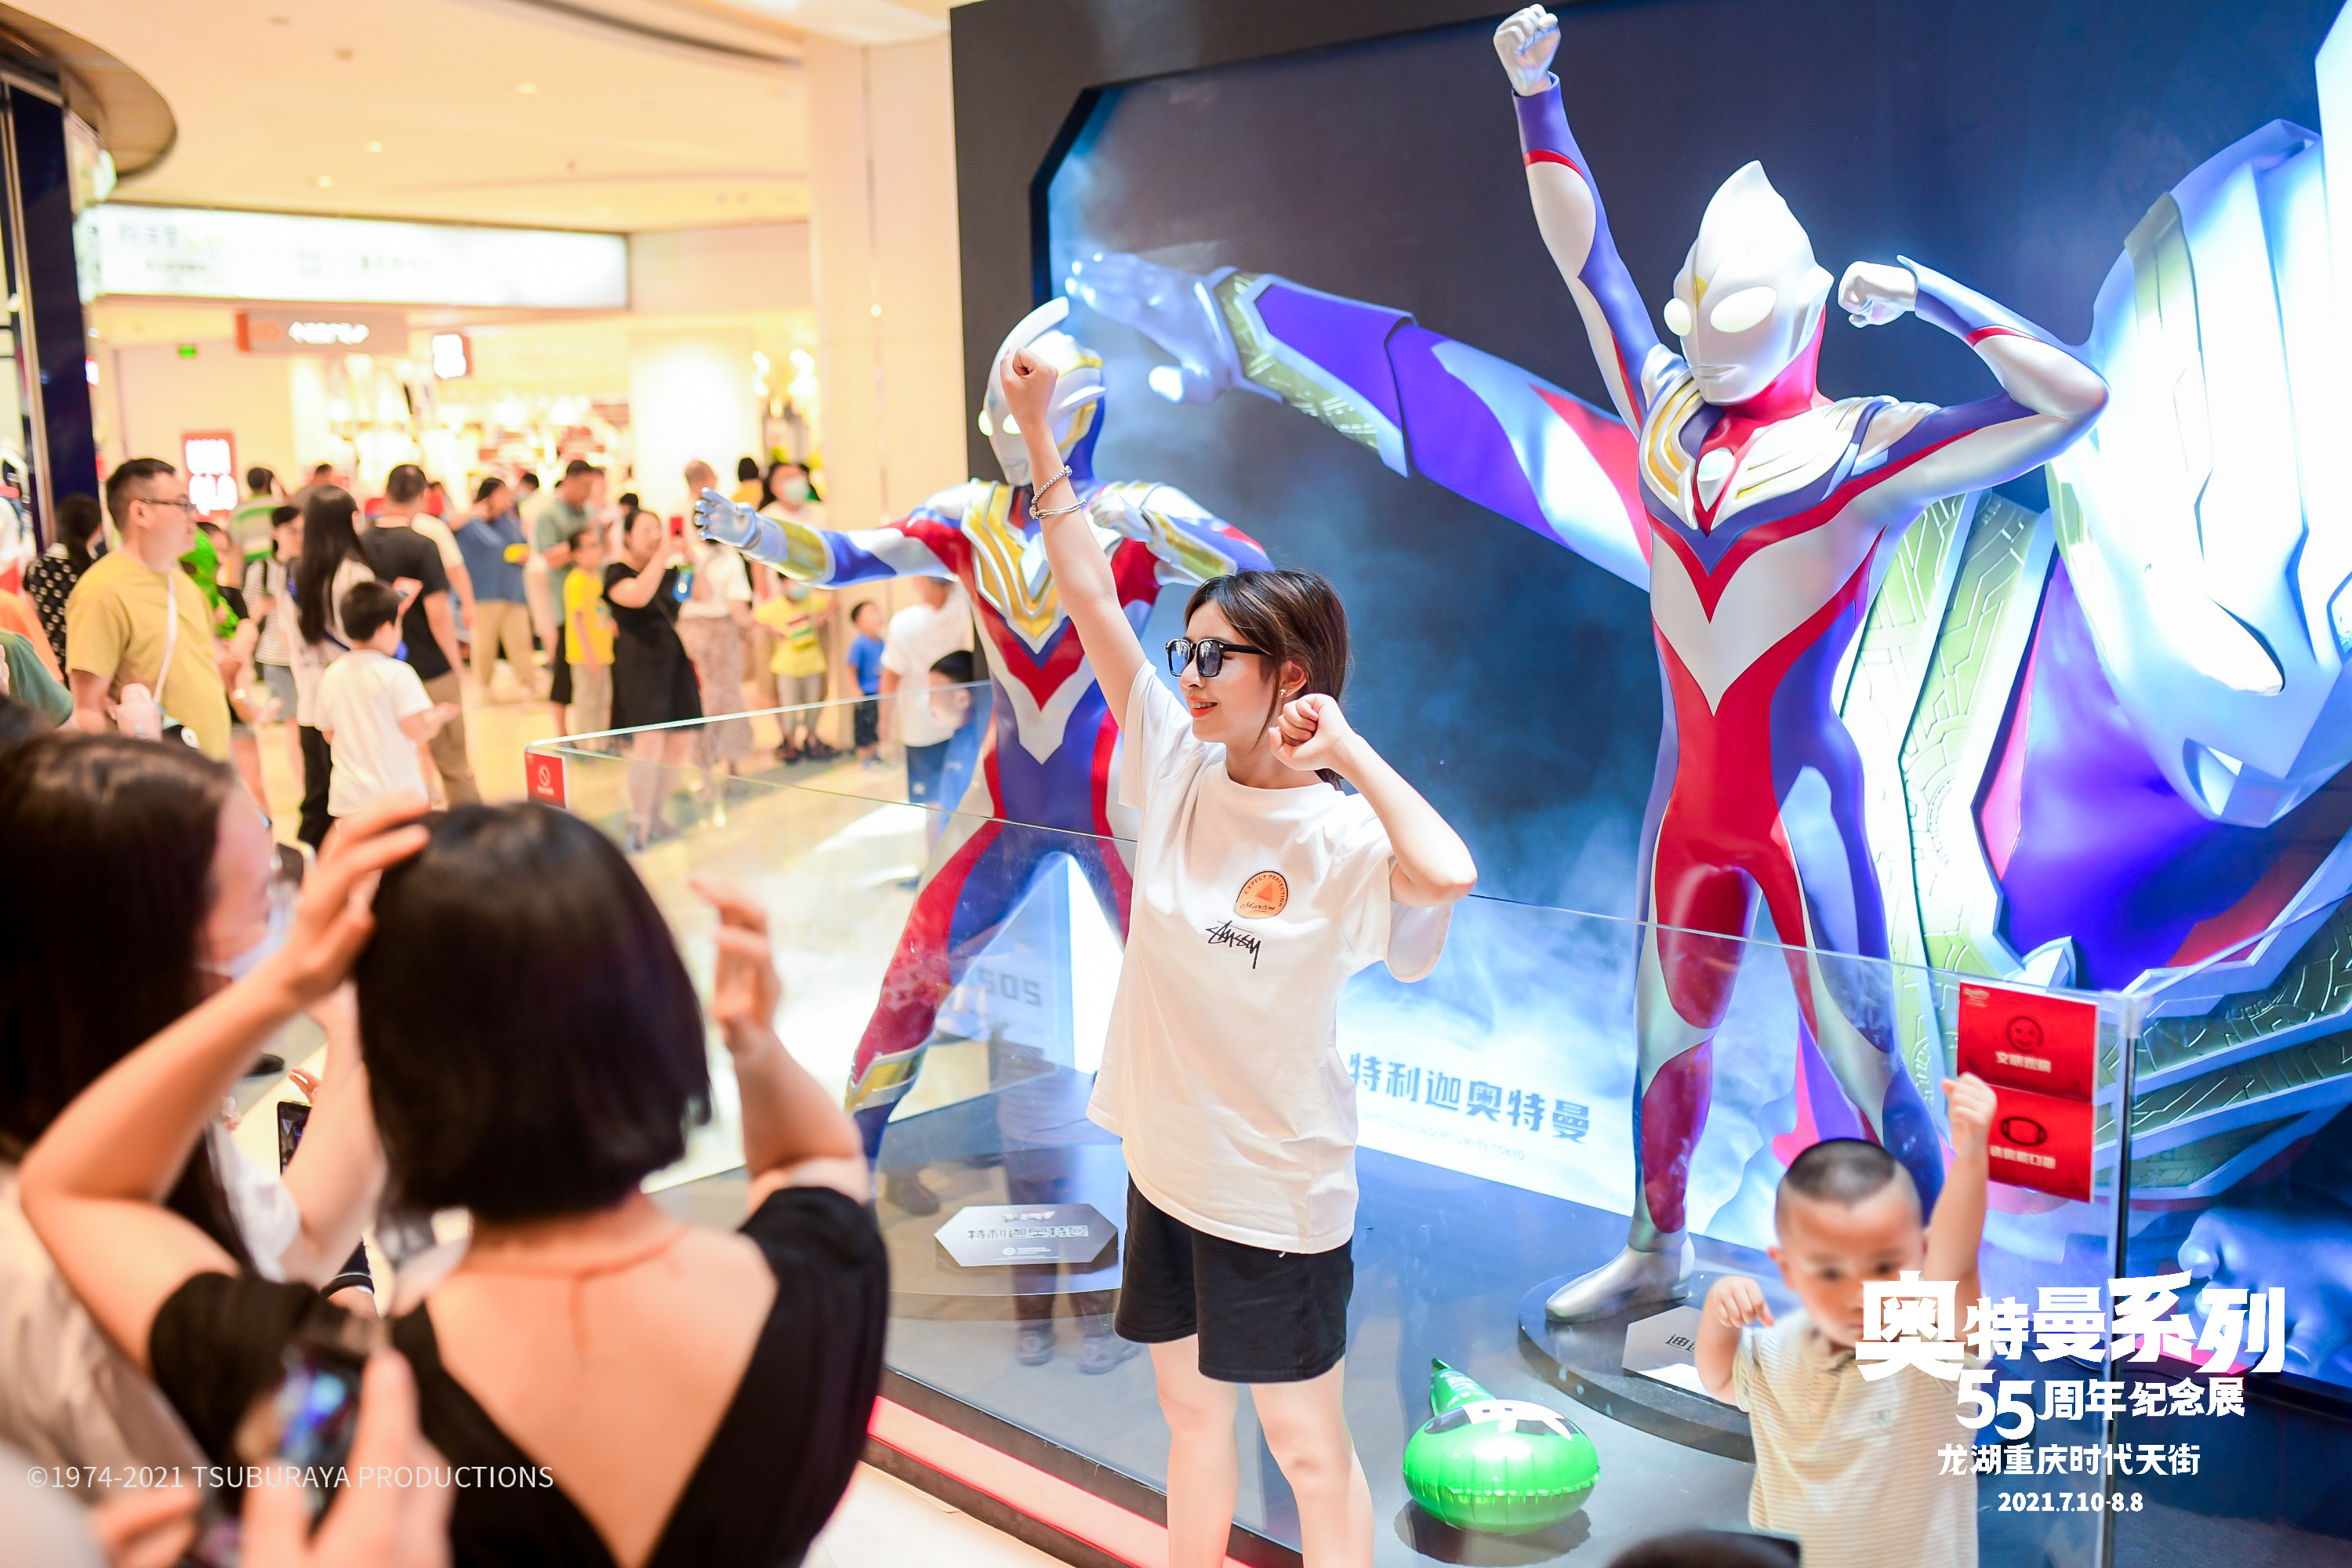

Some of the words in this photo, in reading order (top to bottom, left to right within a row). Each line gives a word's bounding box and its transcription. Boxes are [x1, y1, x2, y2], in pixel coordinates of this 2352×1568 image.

[1243, 874, 1267, 895] EXPECT
[1349, 1053, 1590, 1145] 特利迦奥特曼
